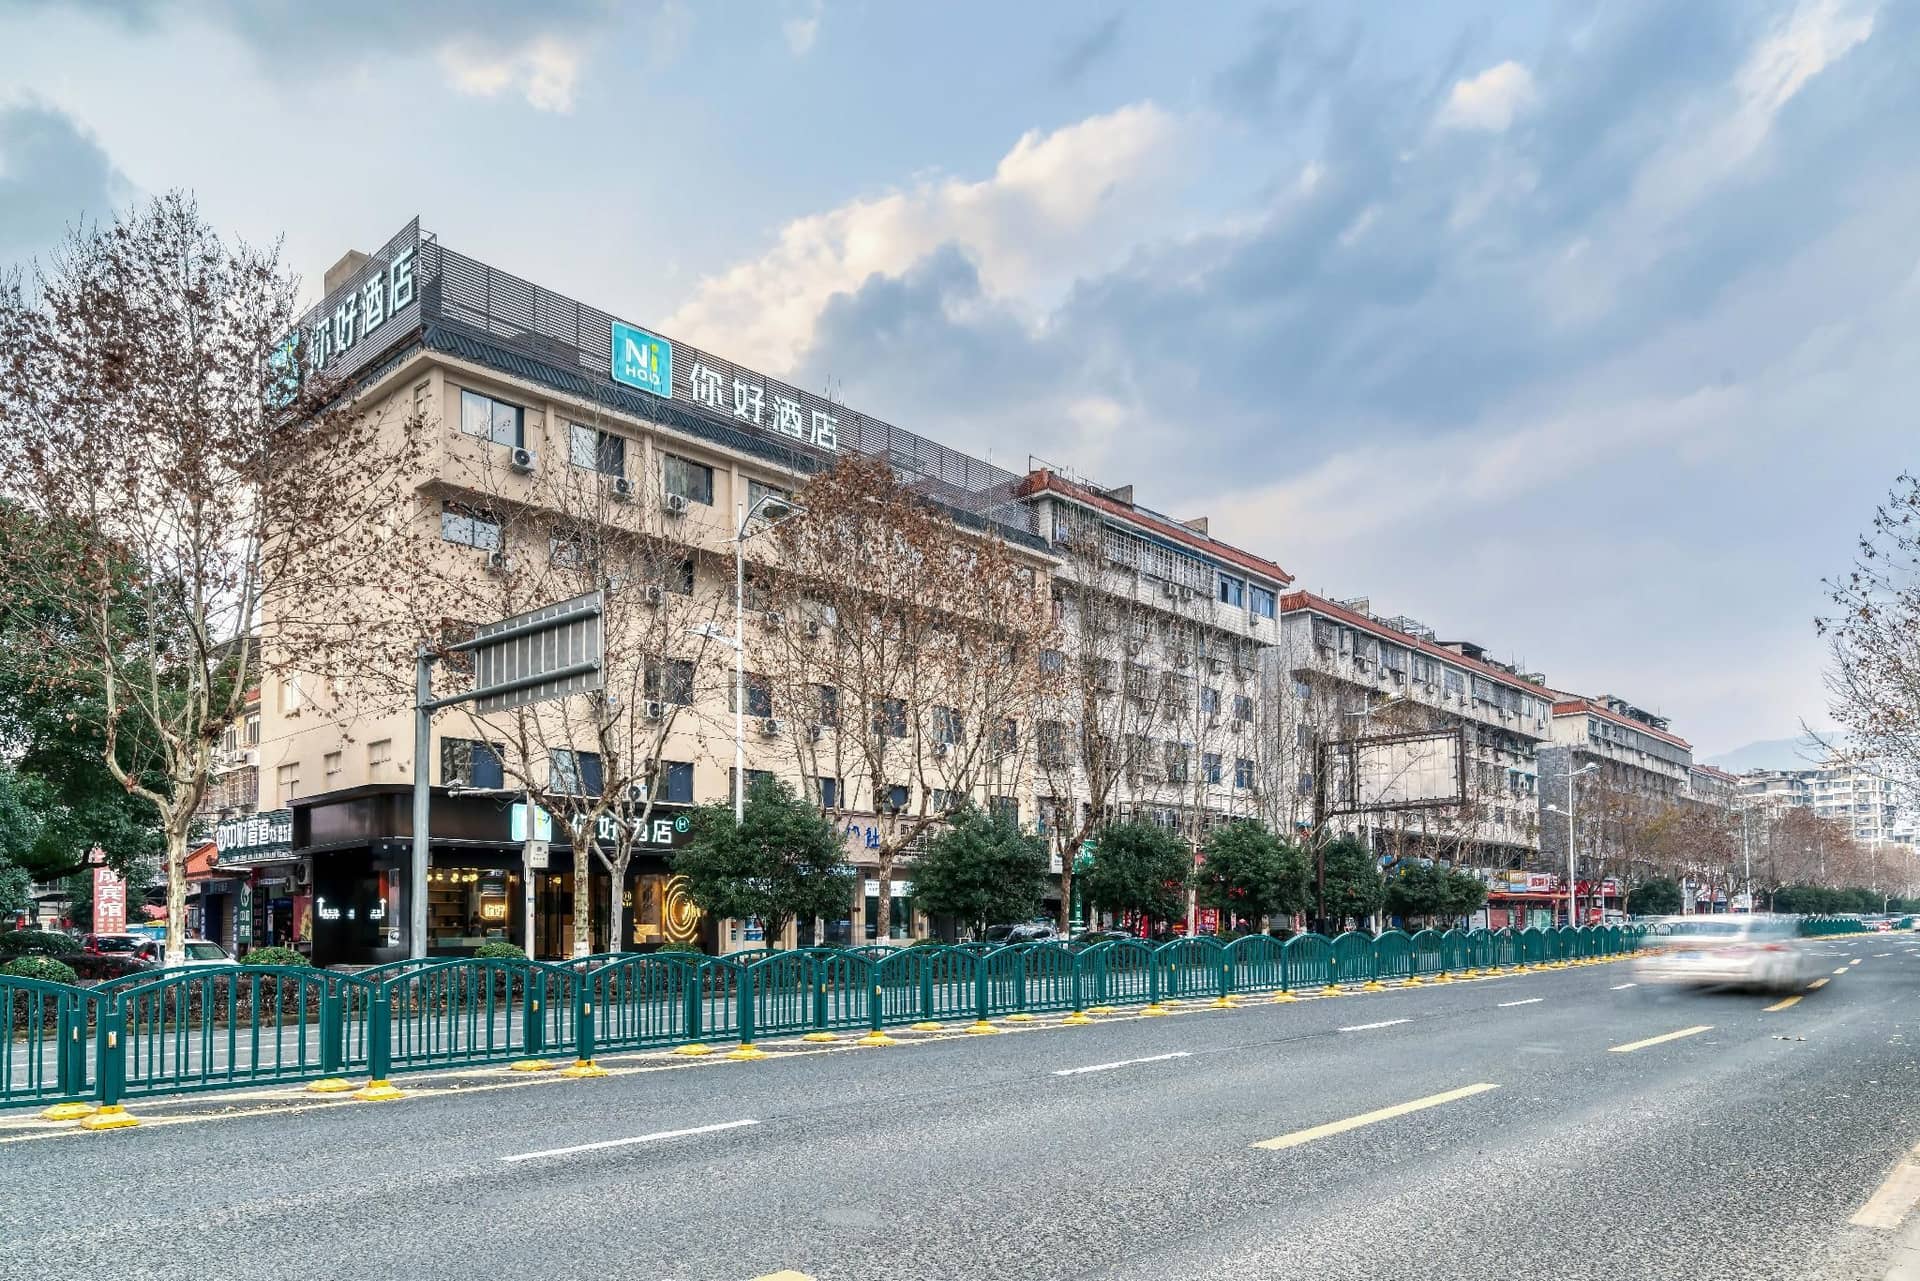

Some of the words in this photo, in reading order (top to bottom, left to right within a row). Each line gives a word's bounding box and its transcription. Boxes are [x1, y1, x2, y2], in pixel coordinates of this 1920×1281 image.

[311, 246, 414, 371] 你好酒店
[626, 337, 658, 372] Ni
[689, 362, 837, 450] 你好酒店
